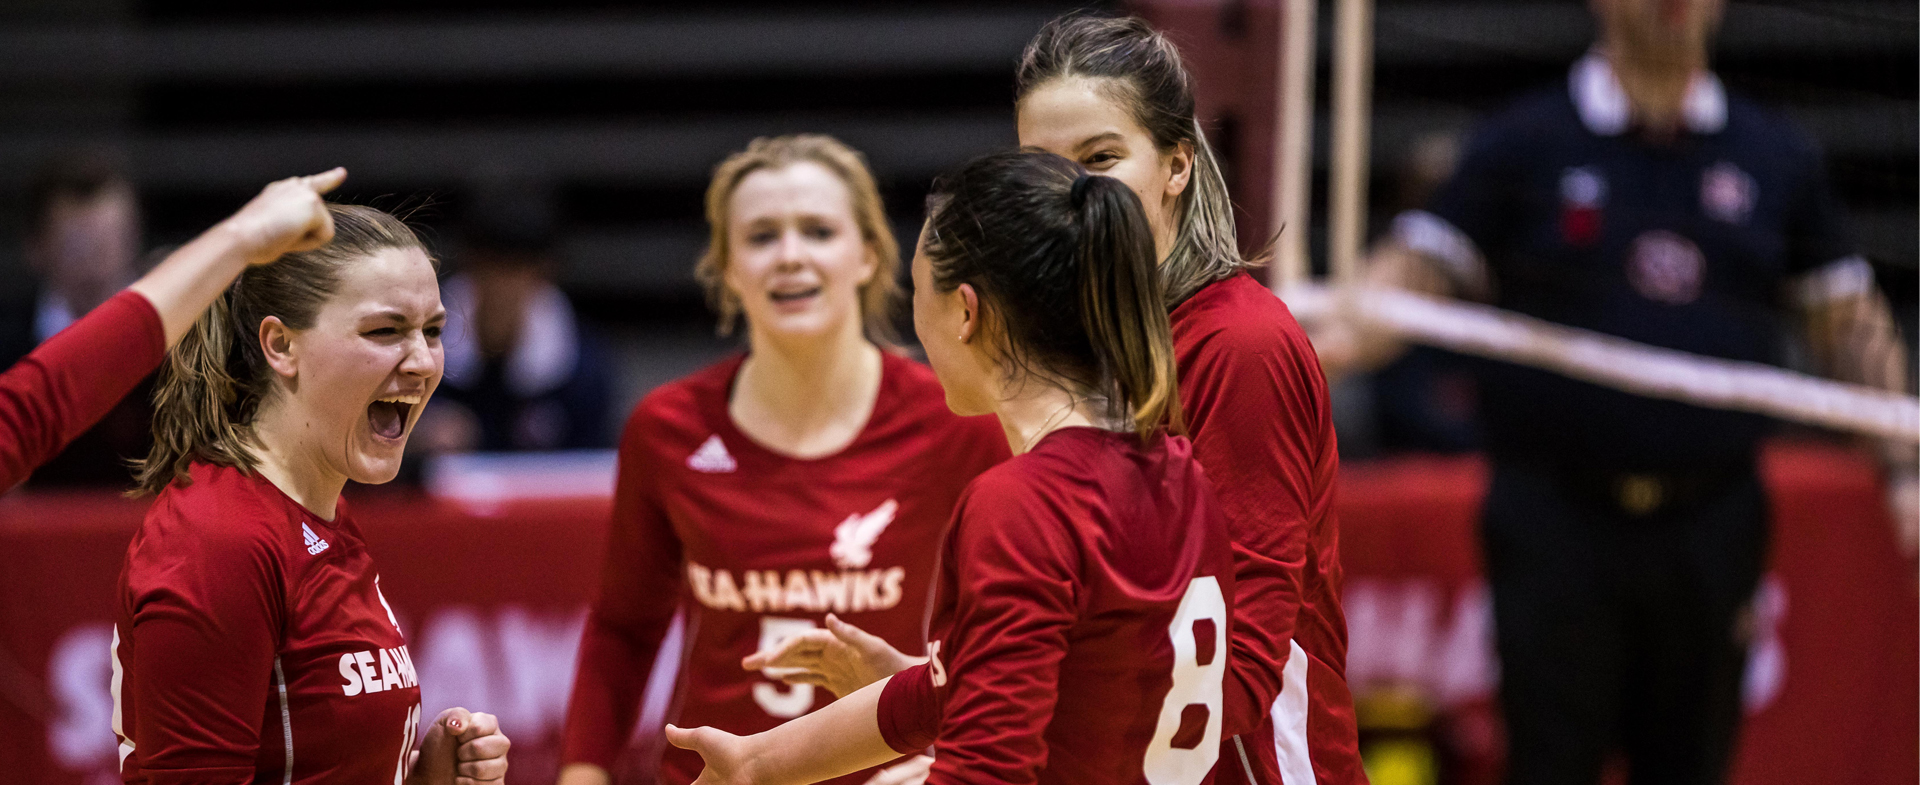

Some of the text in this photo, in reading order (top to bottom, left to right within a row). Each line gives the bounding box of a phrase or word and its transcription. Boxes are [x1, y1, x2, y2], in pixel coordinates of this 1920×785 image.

[688, 561, 905, 612] AHAWKS
[927, 639, 948, 688] S
[1143, 576, 1227, 785] 8
